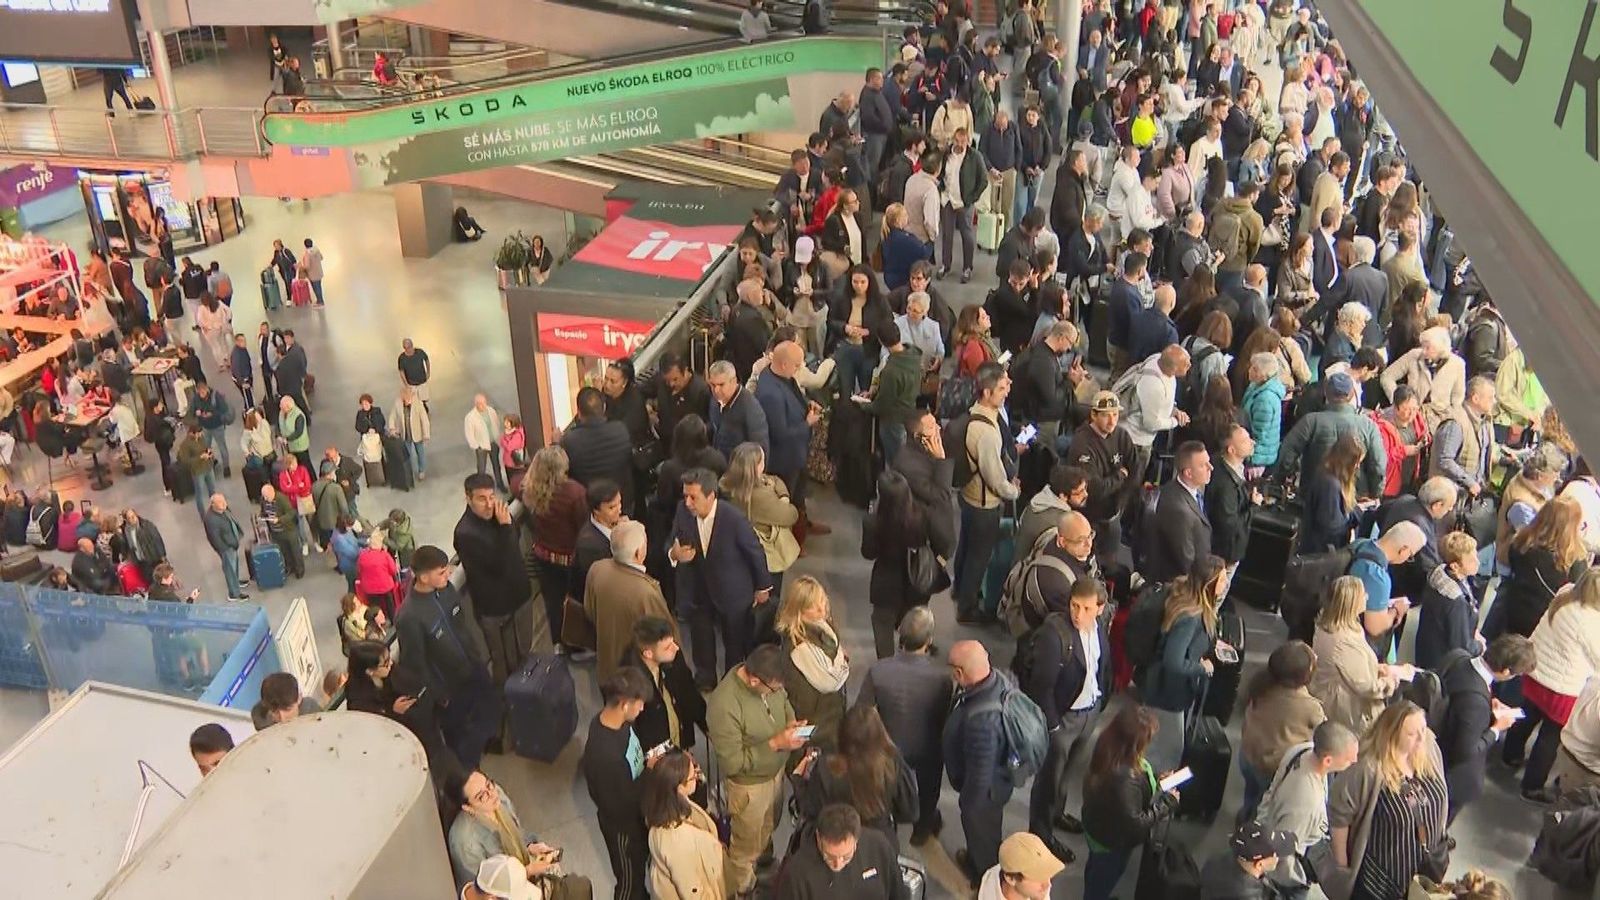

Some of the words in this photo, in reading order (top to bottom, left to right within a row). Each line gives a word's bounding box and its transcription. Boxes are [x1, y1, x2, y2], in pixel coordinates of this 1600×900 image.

[567, 81, 606, 97] NUEVO
[652, 68, 692, 83] ELROQ
[696, 62, 725, 76] 100%
[728, 51, 794, 71] ELÉCTRICO
[464, 131, 480, 148] SÉ
[483, 128, 512, 145] MÁS
[610, 106, 658, 124] ELROQ
[467, 149, 491, 163] CON
[494, 145, 529, 158] HASTA
[552, 138, 570, 150] KM
[573, 135, 587, 147] DE
[590, 124, 661, 144] AUTONOMÍA
[16, 170, 53, 194] renfe
[554, 327, 588, 341] Espacio
